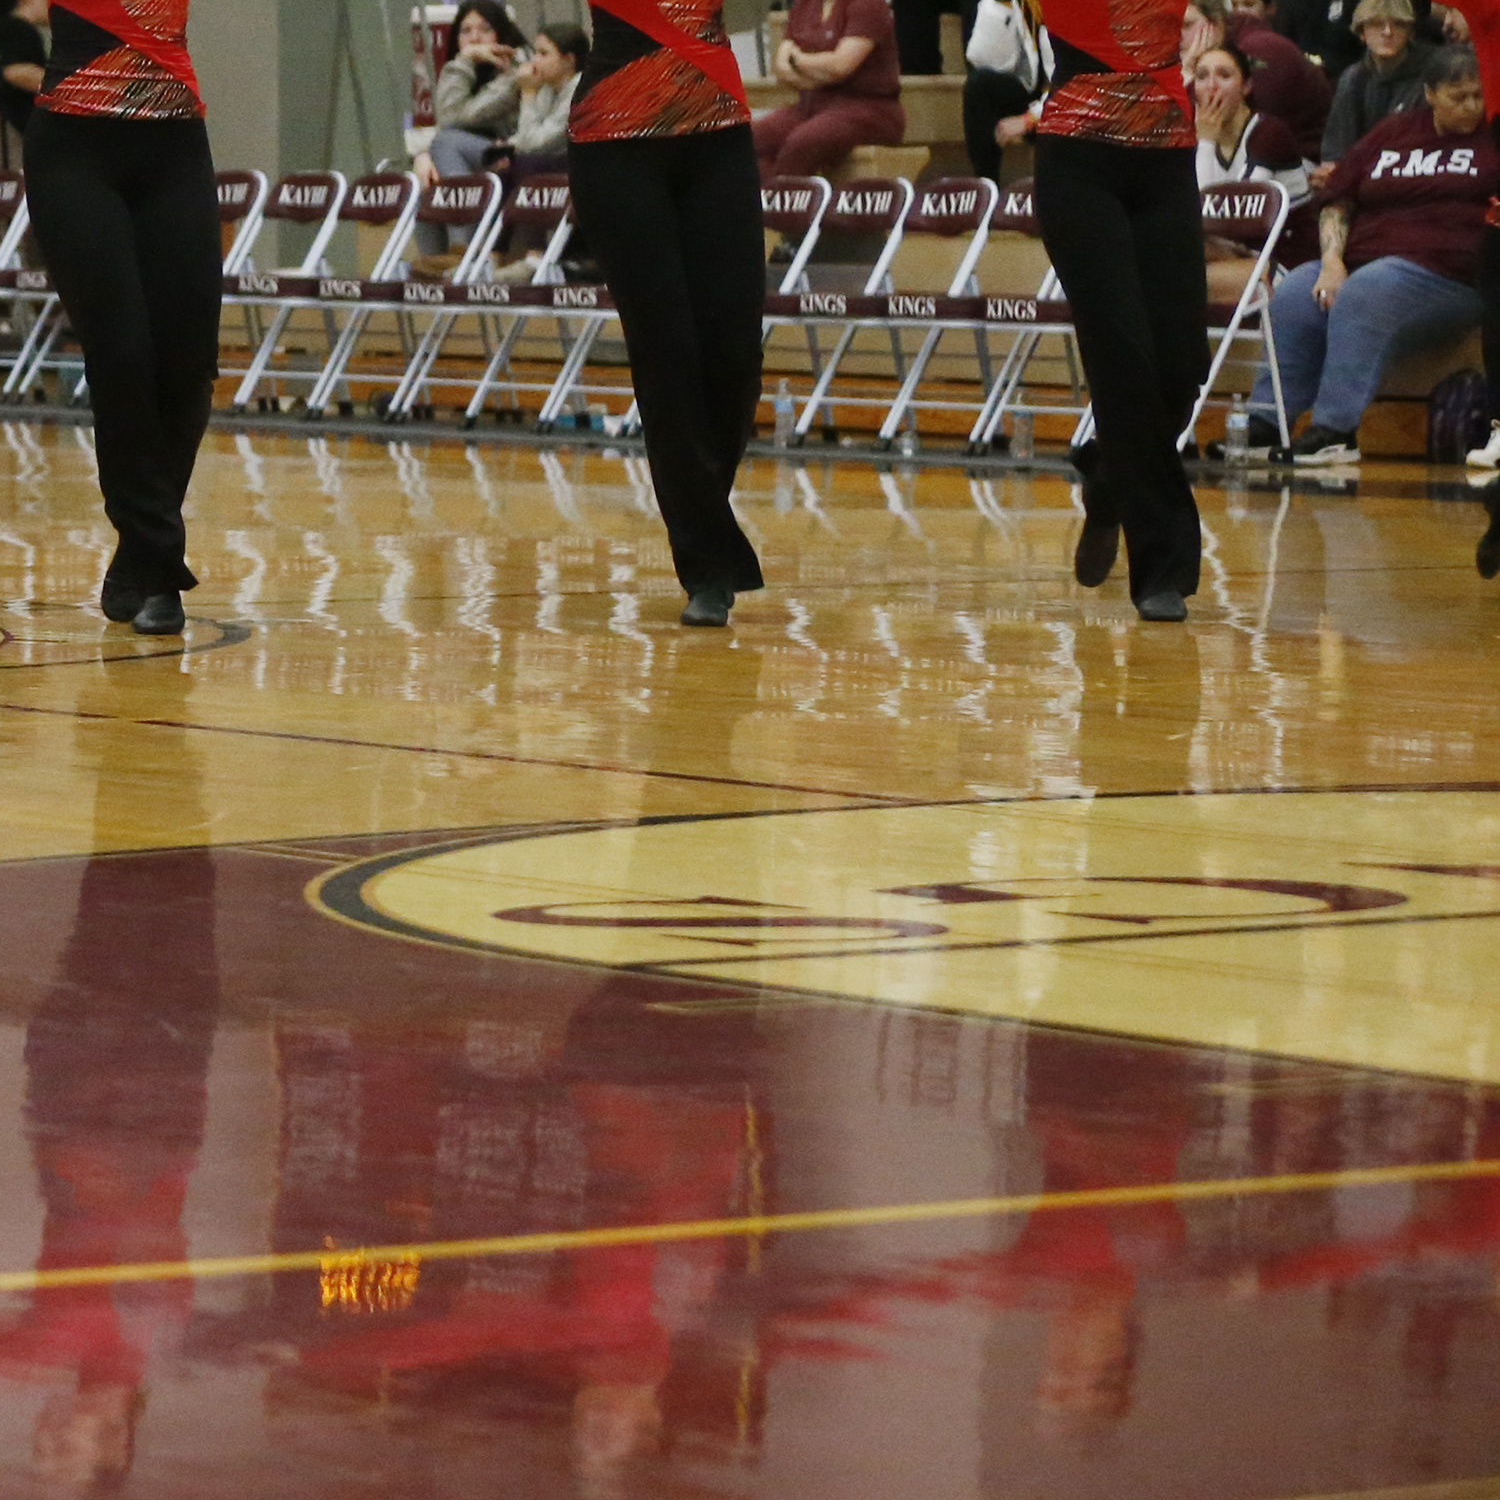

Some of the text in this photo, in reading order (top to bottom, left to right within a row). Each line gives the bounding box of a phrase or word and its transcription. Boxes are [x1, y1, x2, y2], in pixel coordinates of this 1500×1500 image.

[1370, 148, 1479, 180] P.M.S.
[278, 184, 328, 207] KAYHI
[352, 185, 401, 207] KAYHI
[431, 186, 483, 209] KAYHI
[515, 186, 570, 209] KAYHI
[836, 190, 893, 215] KAYHI
[921, 190, 977, 217] KAYHI
[1202, 194, 1267, 218] KAYHI
[403, 282, 444, 301] KINGS
[467, 283, 510, 301] KINGS
[553, 286, 598, 306] KINGS
[800, 294, 847, 314] KINGS
[888, 296, 936, 316] KINGS
[986, 298, 1038, 320] KINGS
